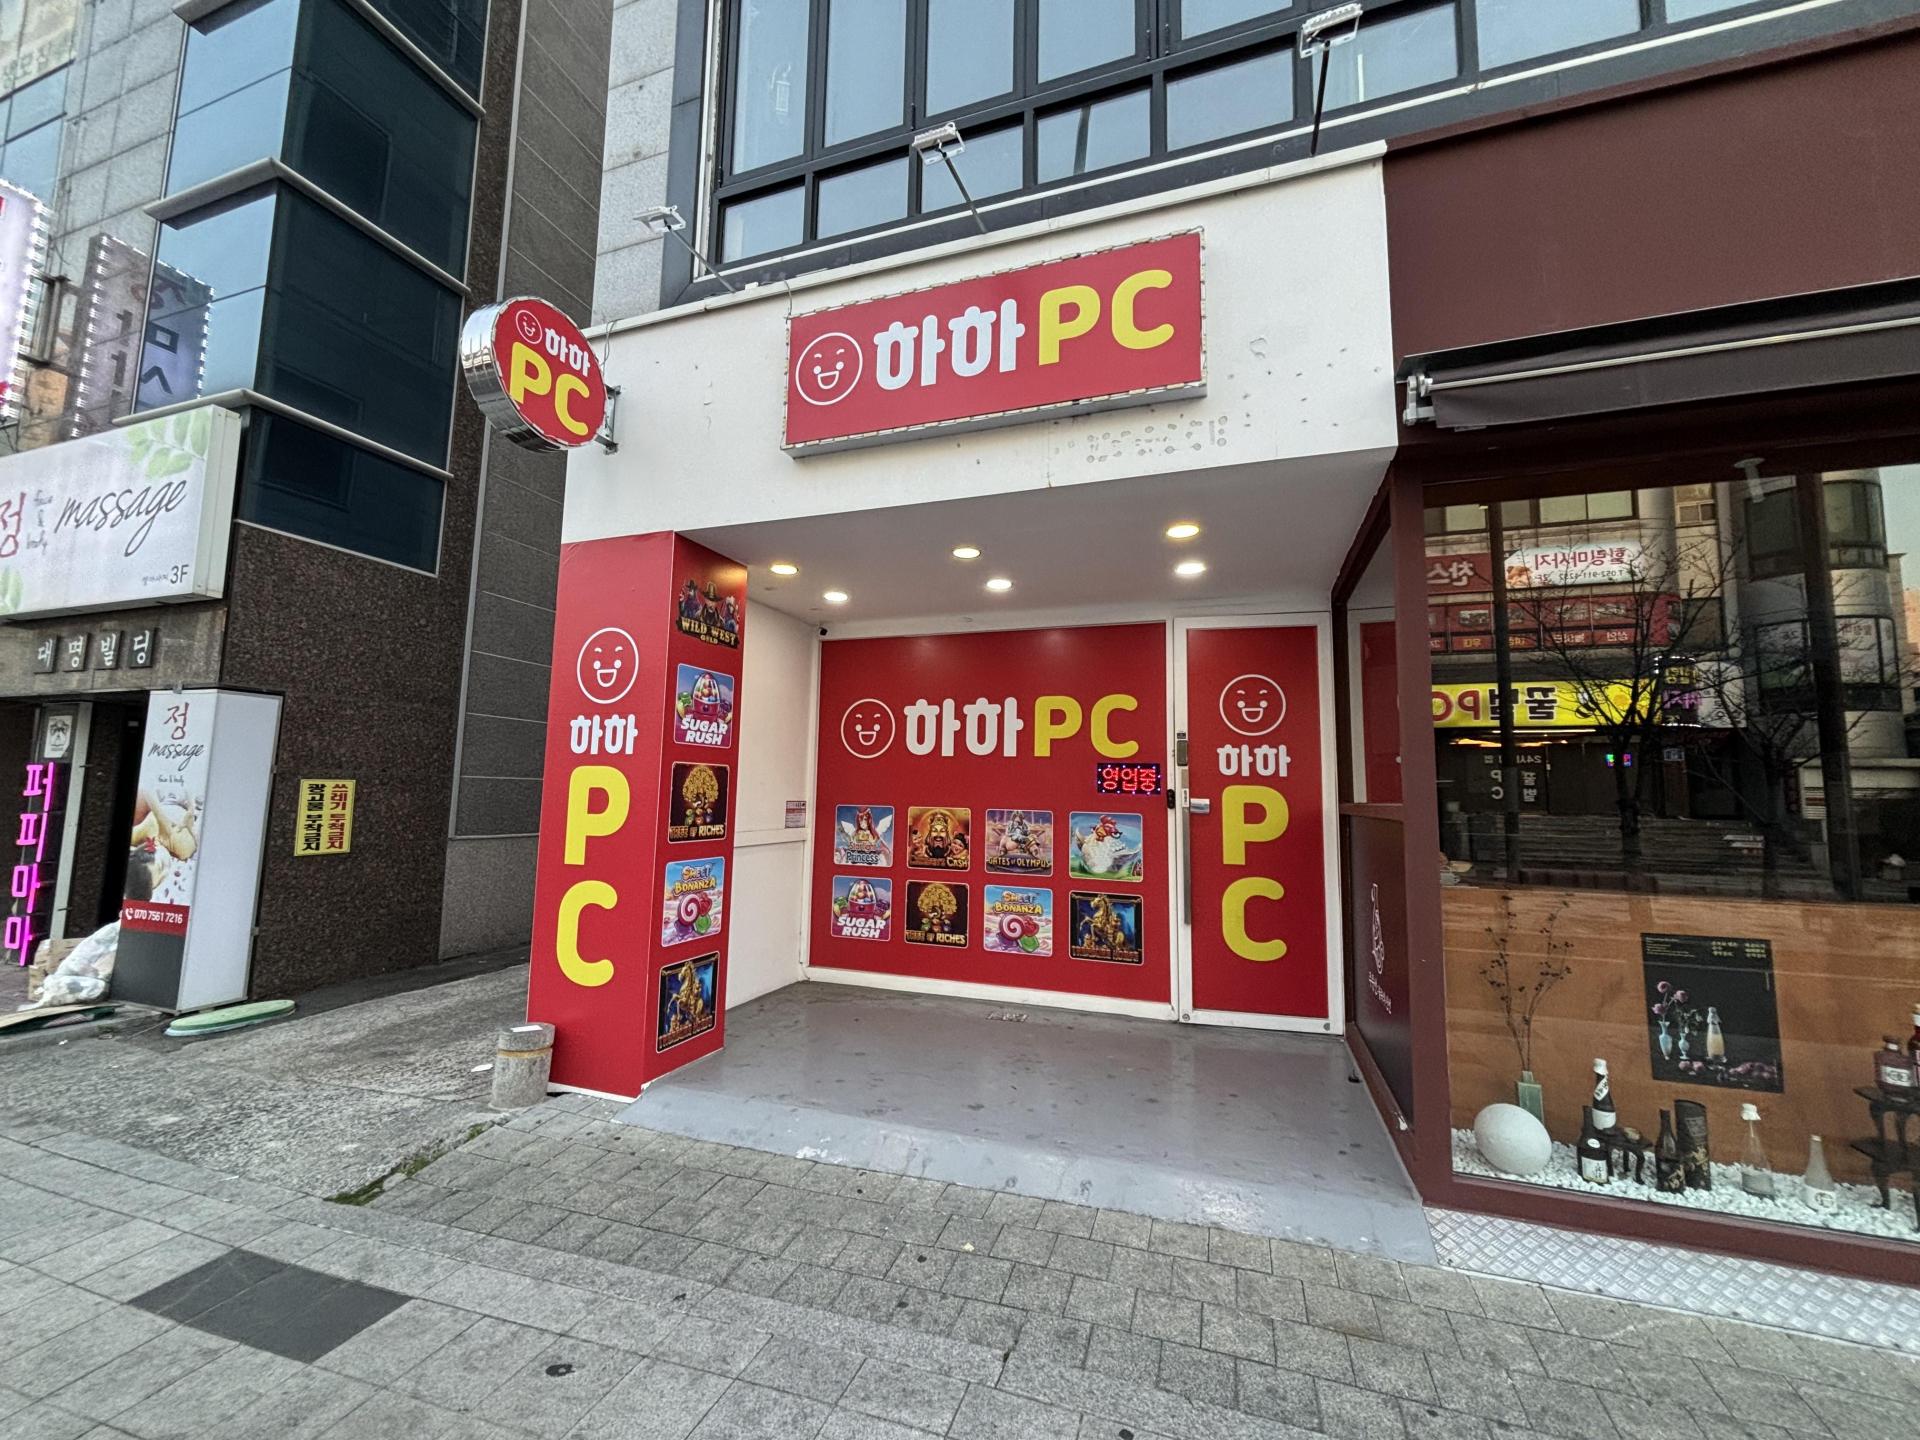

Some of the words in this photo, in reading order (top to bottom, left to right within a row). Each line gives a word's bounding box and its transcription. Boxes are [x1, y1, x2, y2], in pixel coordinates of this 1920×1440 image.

[545, 327, 591, 377] 하하
[509, 341, 590, 436] PC
[55, 480, 187, 557] massage
[170, 564, 189, 584] 3F
[681, 617, 707, 635] WILD
[711, 628, 737, 646] WEST
[38, 630, 149, 668] 대명빌딩
[163, 702, 190, 740] 정
[681, 716, 729, 736] SUGAR
[570, 713, 638, 755] 하하
[685, 730, 723, 746] RUSH
[148, 743, 204, 772] massage
[1217, 744, 1291, 777] 하하
[1102, 767, 1156, 792] 영업중
[307, 784, 327, 811] 광고물
[330, 784, 348, 811] 쓰레기
[303, 814, 324, 851] 부착금지
[326, 814, 347, 849] 투척금지
[698, 824, 724, 837] RICHES
[5, 762, 54, 966] 퍼피마마
[846, 852, 880, 864] Princess
[989, 856, 1011, 865] GATES
[1017, 858, 1052, 868] OLYMPUS
[682, 865, 712, 881] SWEET
[674, 878, 716, 896] BONANZA
[1003, 891, 1036, 904] SWEET
[134, 909, 147, 920] 070
[165, 913, 183, 924] 7216
[995, 903, 1042, 915] BONANZA
[837, 916, 886, 929] SUGAR
[842, 927, 881, 939] RUSH
[936, 933, 966, 945] RICHES
